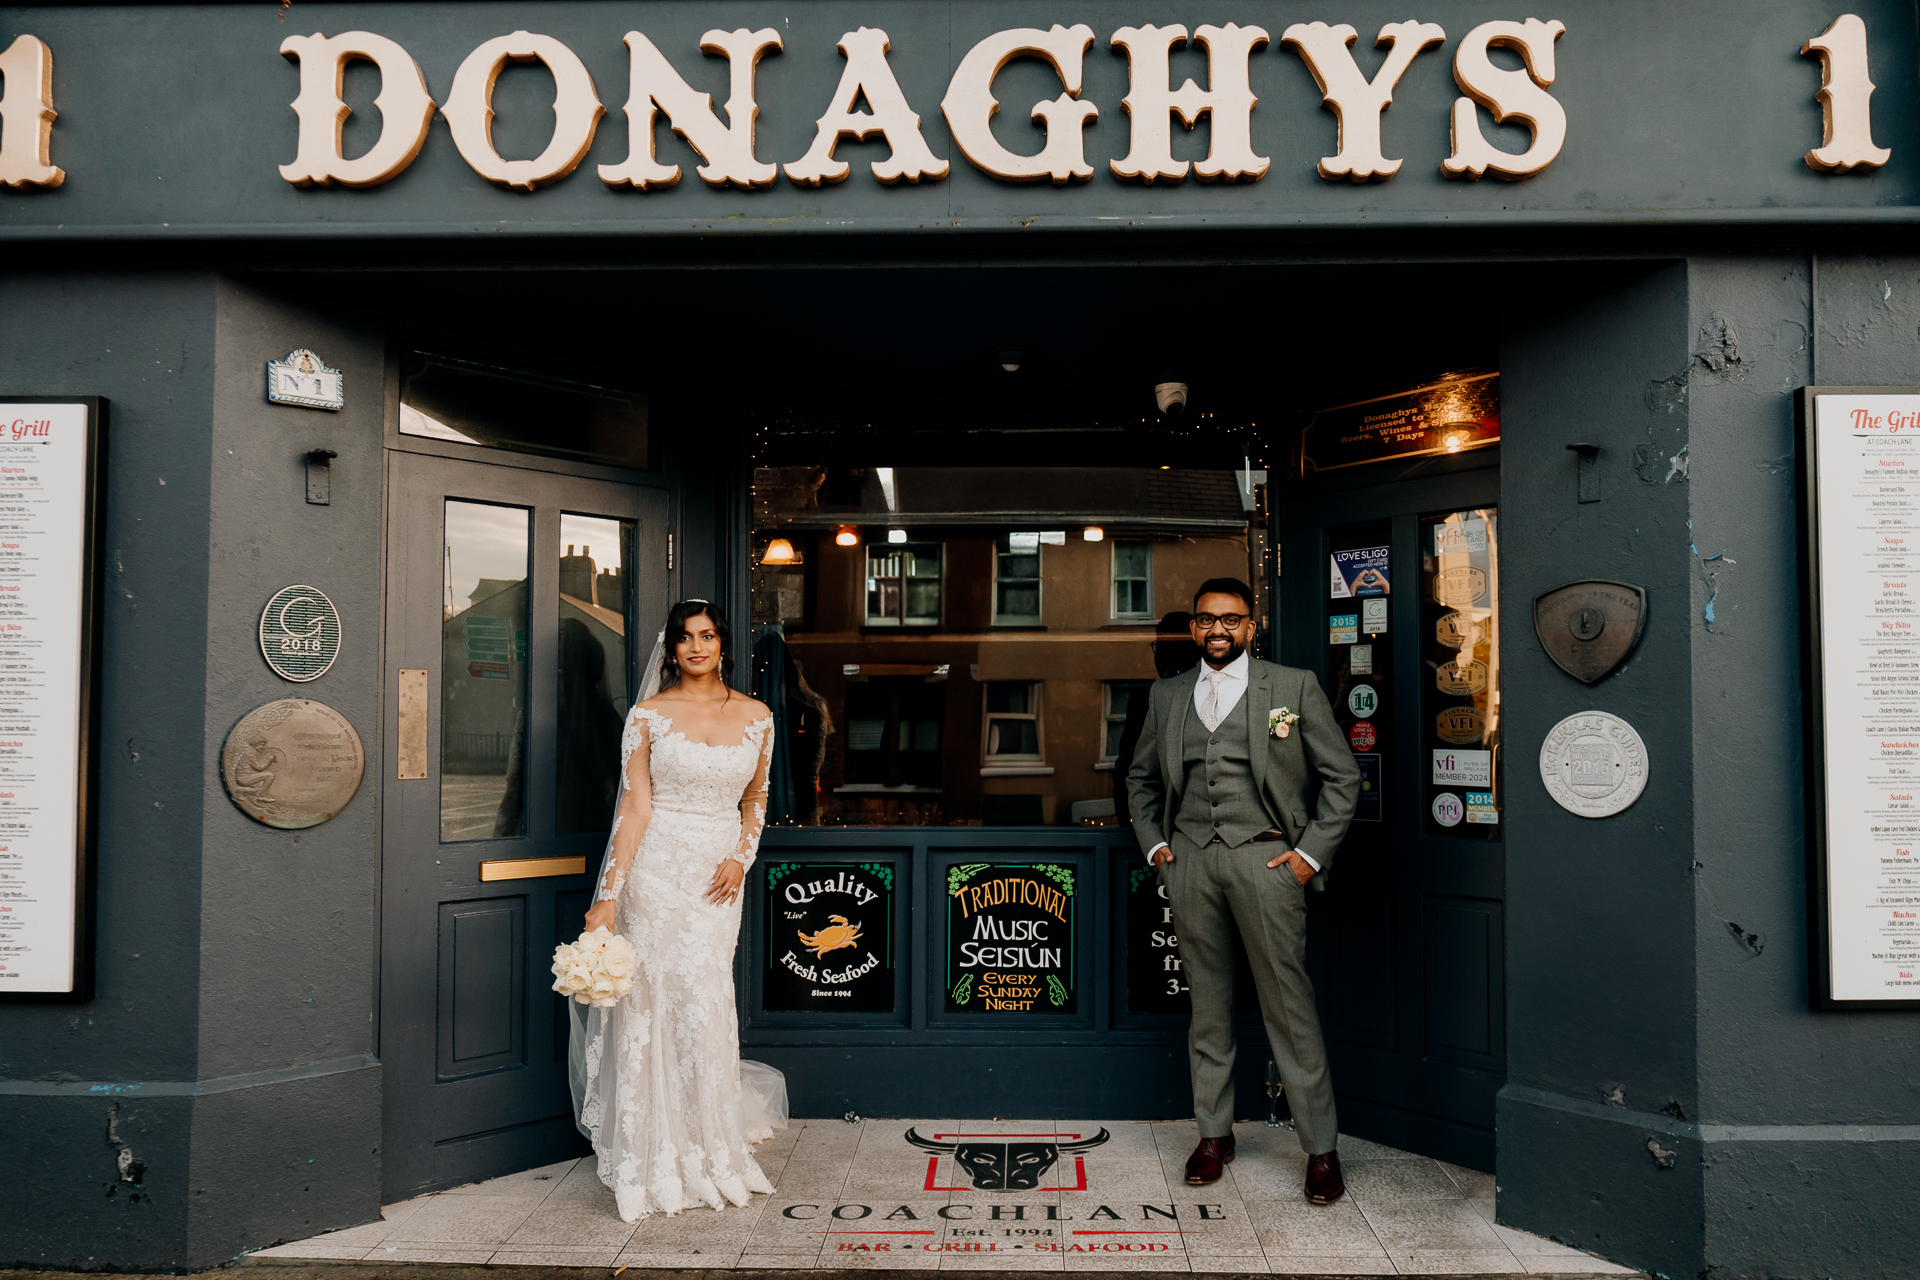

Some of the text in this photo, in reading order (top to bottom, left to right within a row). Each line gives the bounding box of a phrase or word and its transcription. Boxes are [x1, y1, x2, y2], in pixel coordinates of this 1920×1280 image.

[1801, 13, 1891, 174] 1
[278, 16, 1566, 191] DONAGHYS
[312, 379, 324, 396] 1
[1364, 407, 1418, 423] Donaghys
[1850, 409, 1920, 433] The Gril
[11, 419, 50, 441] Grill
[1359, 417, 1406, 432] Licensed
[1379, 425, 1412, 436] Wines
[1418, 421, 1428, 429] &
[1396, 431, 1424, 442] Days
[1878, 459, 1905, 467] Starters
[1883, 537, 1904, 545] Soups
[1337, 548, 1388, 562] LOVE SLIGO
[1600, 592, 1617, 601] THE
[1618, 596, 1639, 611] YEAR
[1332, 617, 1355, 627] 2015
[1881, 621, 1893, 630] Big
[281, 639, 321, 651] 2018
[1354, 693, 1374, 710] 14
[1448, 718, 1473, 730] VFI
[1352, 736, 1367, 746] yelp
[1609, 725, 1642, 777] GUIDES
[1435, 754, 1455, 770] vfi
[1435, 773, 1488, 782] MEMBER 2024
[1889, 793, 1913, 801] Salads
[1438, 805, 1457, 815] PPI
[785, 872, 879, 906] Quality
[954, 878, 1067, 923] TRADITIONAL
[1151, 930, 1178, 948] Se
[780, 949, 880, 985] Fresh Seafood
[1163, 955, 1182, 971] fr
[811, 989, 832, 997] Since
[1166, 978, 1190, 995] 3-
[781, 1204, 1227, 1221] COACHLANE
[952, 1228, 1053, 1237] Est. 1994
[838, 1243, 1169, 1253] BAR GRILL SEAFOOD
